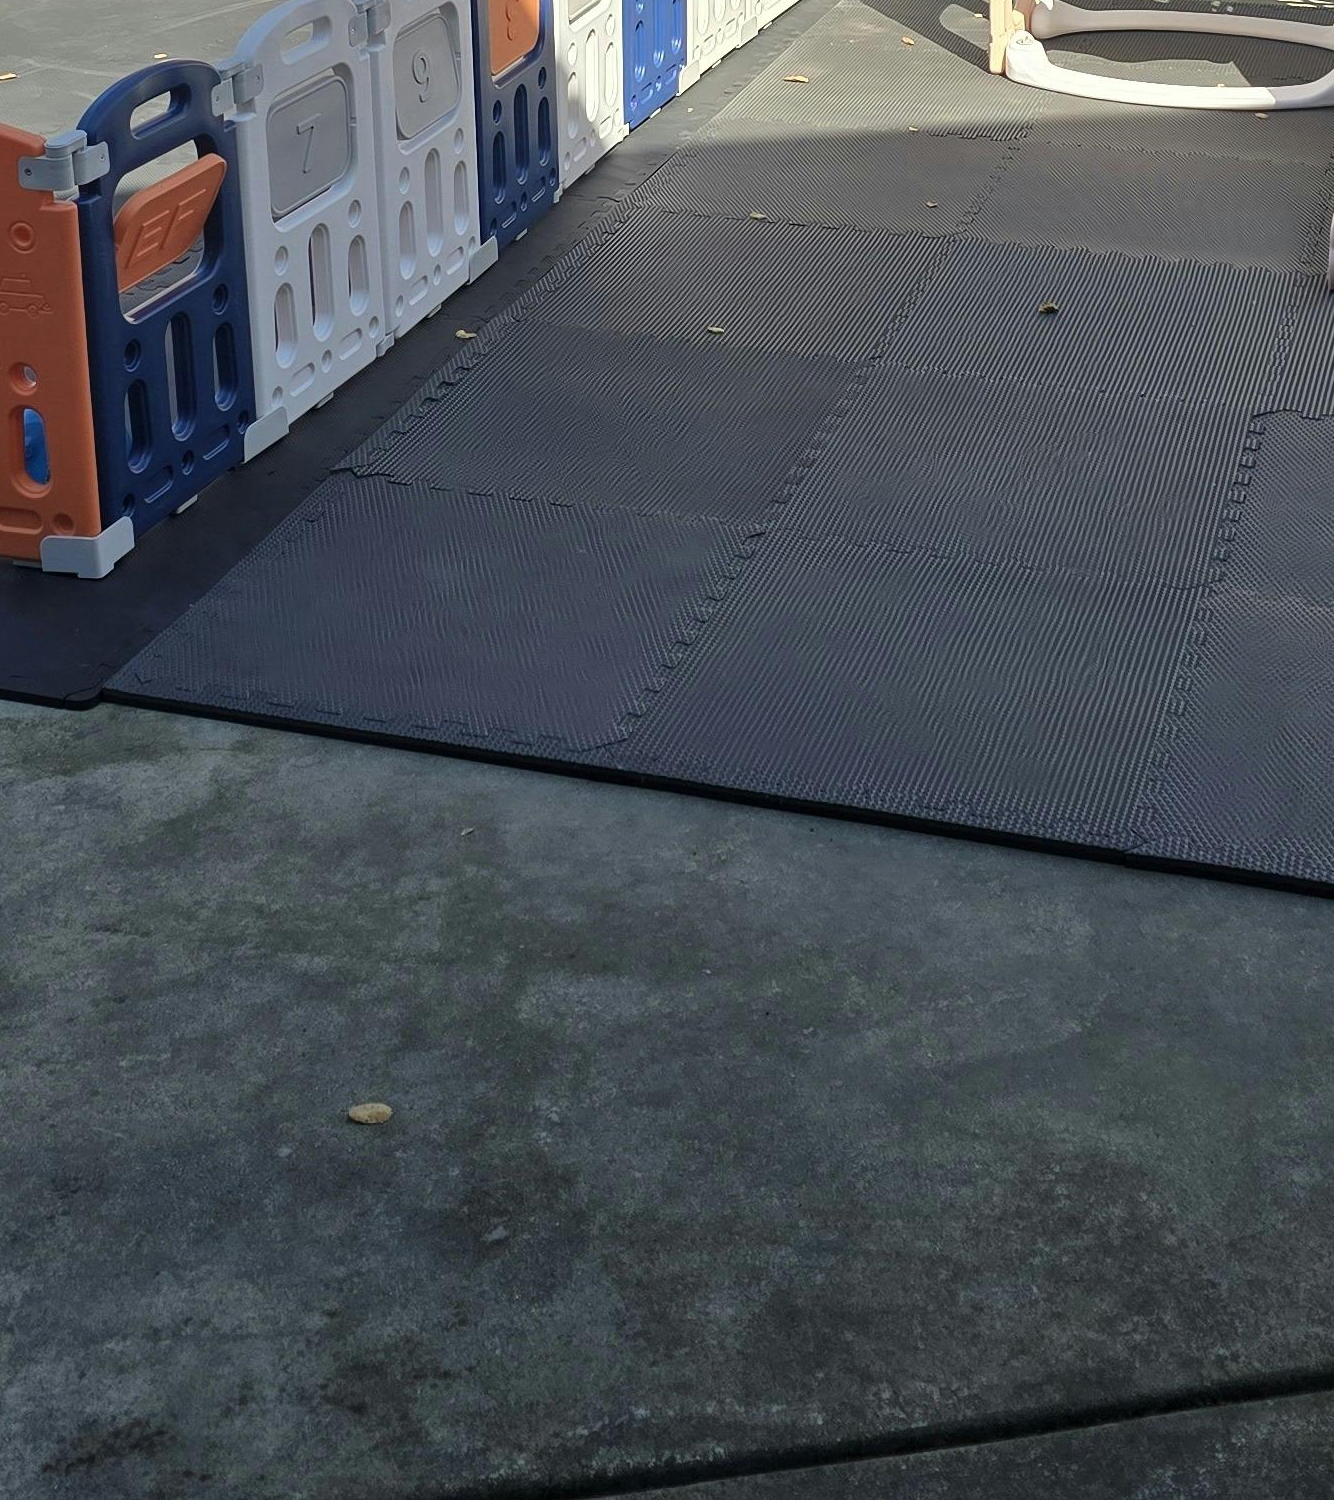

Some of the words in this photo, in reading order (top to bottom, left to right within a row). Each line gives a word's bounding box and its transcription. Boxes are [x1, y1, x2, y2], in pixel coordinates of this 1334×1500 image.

[411, 50, 430, 103] 9
[296, 112, 322, 174] 7
[124, 188, 207, 272] EF
